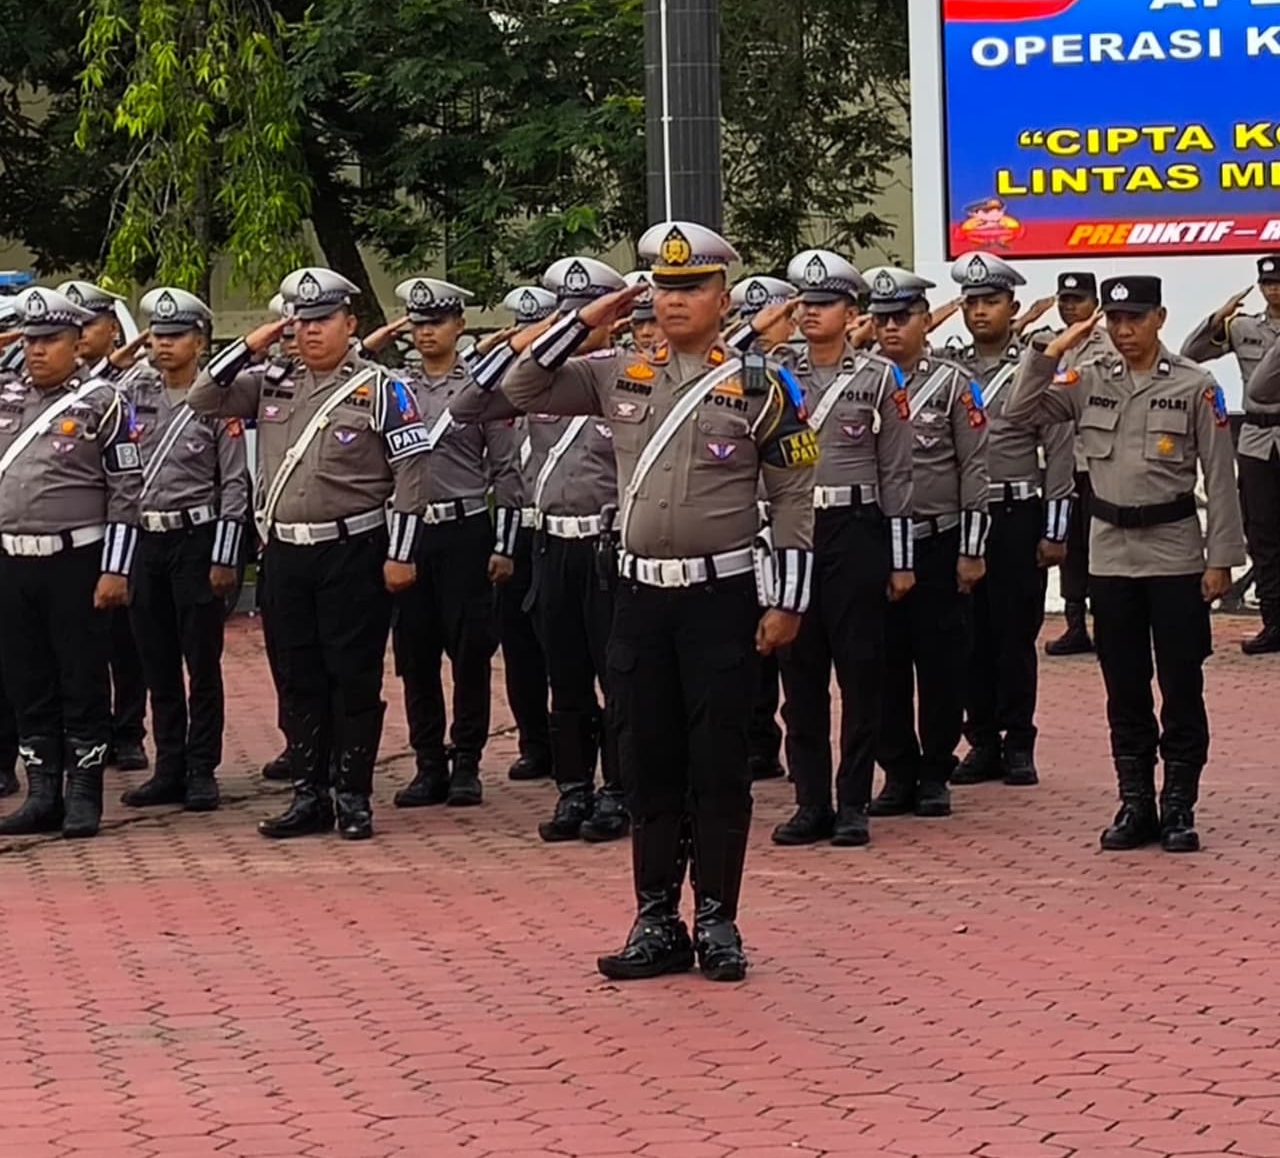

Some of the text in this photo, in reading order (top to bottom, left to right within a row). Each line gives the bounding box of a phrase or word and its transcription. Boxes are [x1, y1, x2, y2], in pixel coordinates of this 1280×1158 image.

[971, 28, 1222, 67] OPERASI
[1017, 125, 1215, 156] “CIPTA
[997, 166, 1200, 195] LINTAS
[1150, 397, 1188, 411] POLRI
